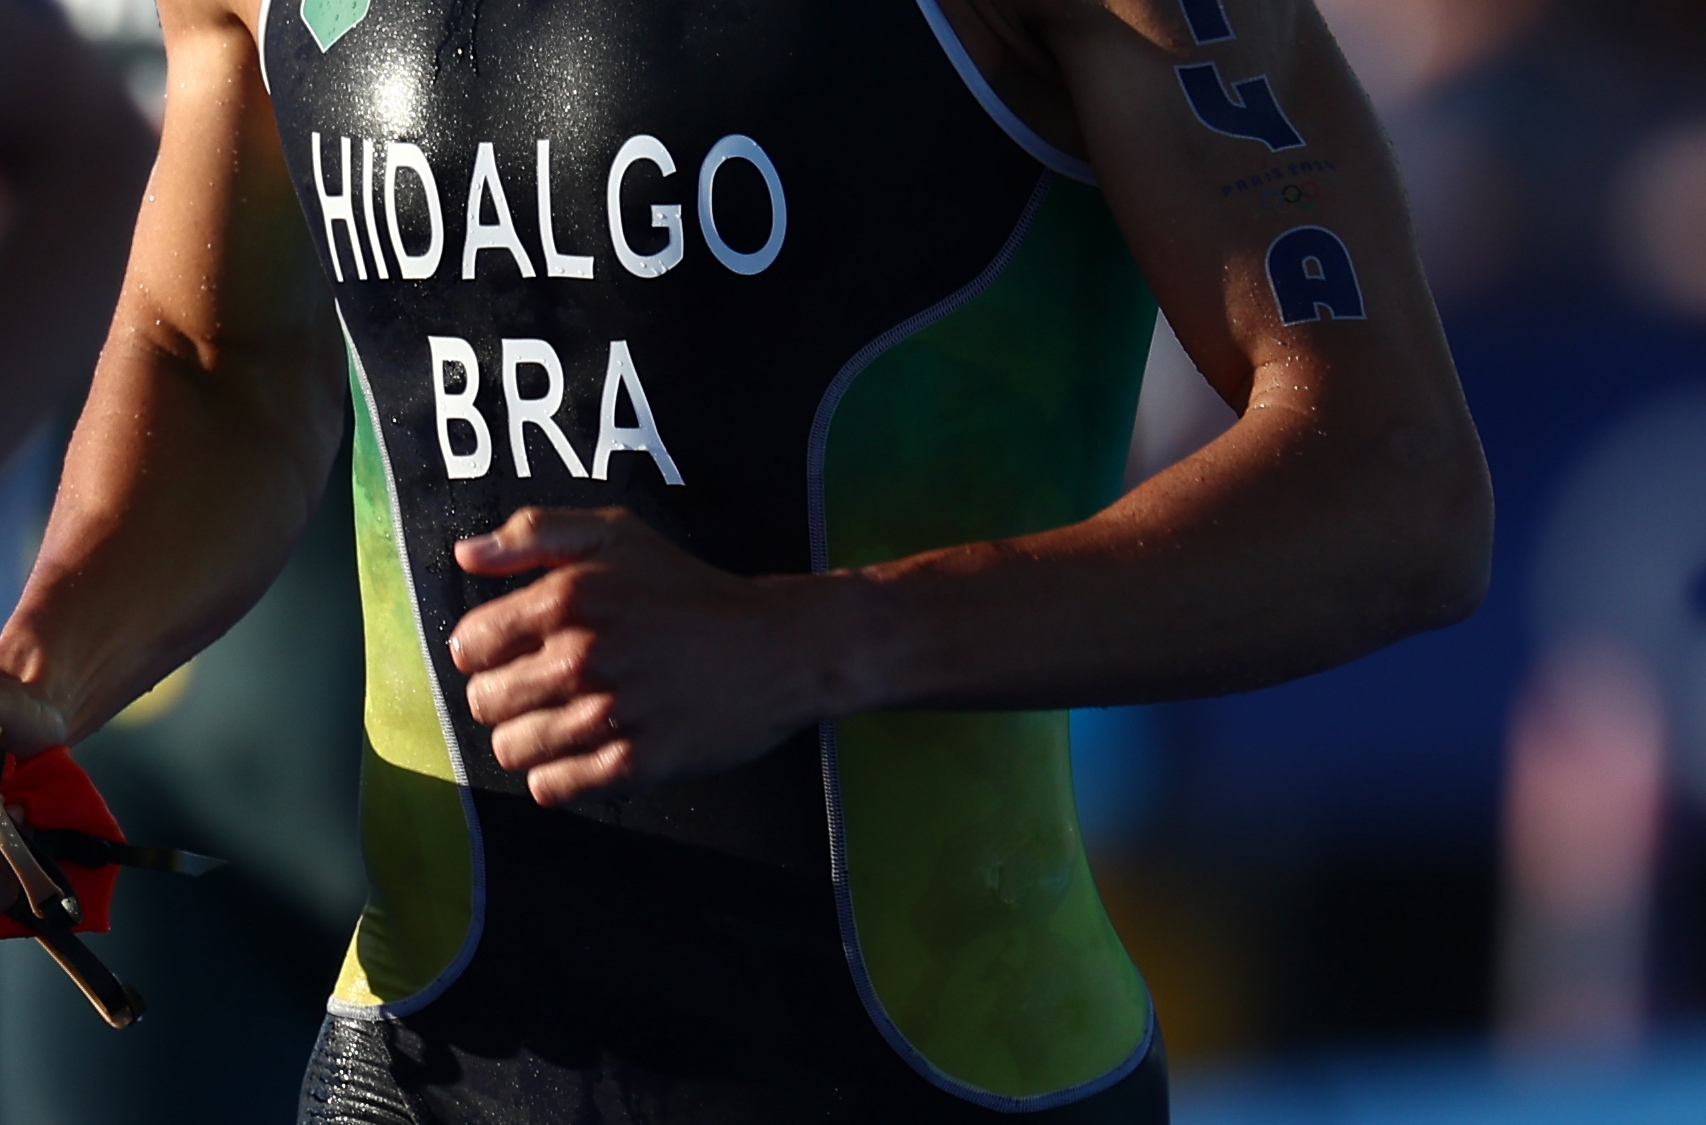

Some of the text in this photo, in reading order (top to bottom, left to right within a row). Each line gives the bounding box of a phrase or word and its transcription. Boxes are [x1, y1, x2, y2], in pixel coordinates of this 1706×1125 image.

[311, 133, 787, 282] HIDALGO
[1264, 225, 1367, 326] A
[427, 335, 685, 486] BRA
